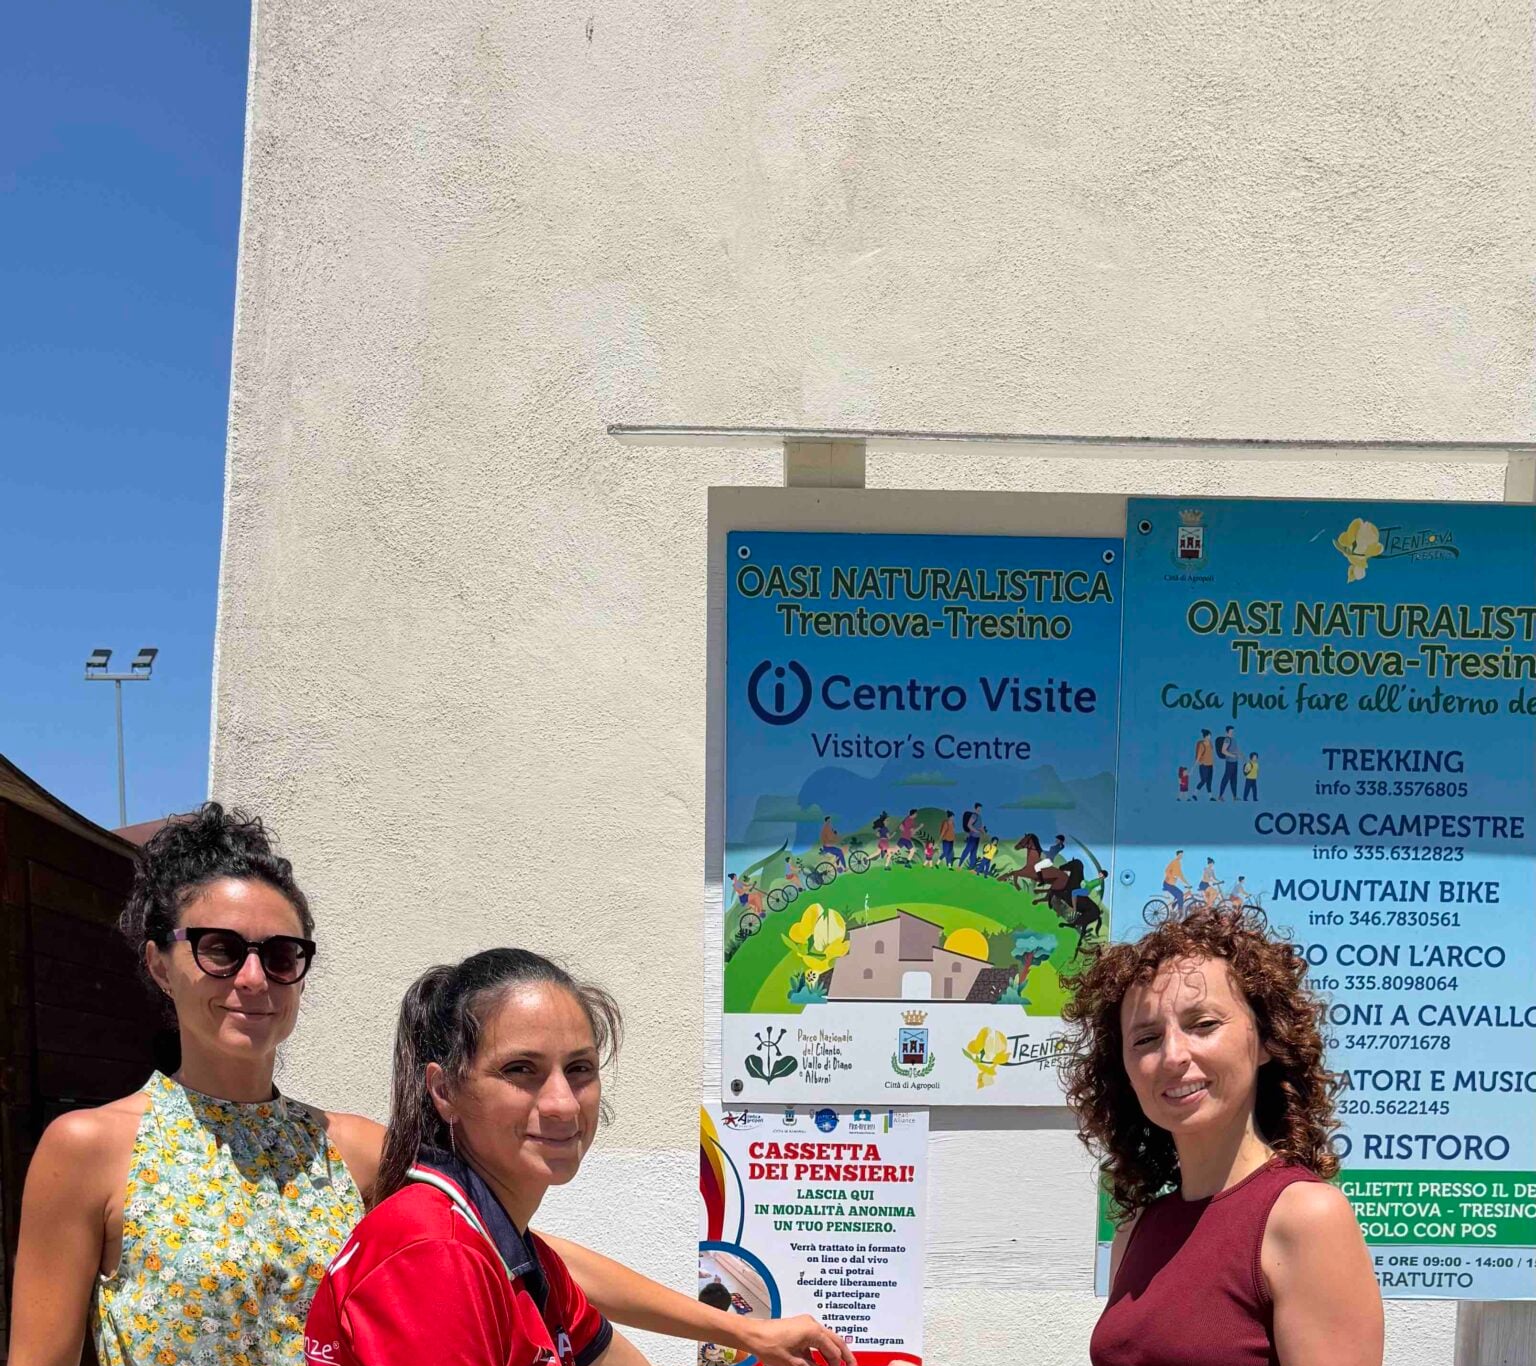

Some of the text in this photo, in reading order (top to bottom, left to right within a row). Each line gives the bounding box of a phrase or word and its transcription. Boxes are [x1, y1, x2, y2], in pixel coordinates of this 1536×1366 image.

[737, 565, 1113, 603] OASI NATURALISTICA
[776, 603, 1072, 640] Trentova-Tresino
[1187, 600, 1536, 641] OASI NATURALIST
[1232, 640, 1536, 680] Trentova-Tresin
[821, 674, 1097, 713] Centro Visite
[1161, 683, 1224, 711] Cosa
[1232, 686, 1288, 718] puoi
[1297, 683, 1349, 714] fare
[1358, 684, 1498, 715] all'interno
[811, 732, 1031, 760] Visitor's Centre
[1322, 748, 1464, 773] TREKKING
[1315, 780, 1468, 798] info 338.3576805
[1254, 811, 1525, 839] CORSA CAMPESTRE
[1313, 845, 1465, 862] info 335.6312823
[1271, 878, 1500, 904] MOUNTAIN BIKE
[1308, 910, 1460, 928] info 346.7830561
[1336, 945, 1400, 967] CON
[1409, 945, 1506, 968] L'ARCO
[1345, 975, 1458, 991] 335.8098064
[1390, 1004, 1410, 1026] A
[797, 1029, 853, 1044] Parco Nazionale
[1345, 1034, 1450, 1050] 347.7071678
[802, 1043, 814, 1056] del
[802, 1057, 853, 1070] Vallo di Diano
[805, 1070, 831, 1085] Alburni
[1431, 1070, 1445, 1091] E
[884, 1081, 940, 1091] Città di Agropoli
[1338, 1100, 1450, 1116] 320.5622145
[749, 1142, 882, 1161] CASSETTA
[1363, 1134, 1511, 1160] RISTORO
[749, 1163, 915, 1182] DEI PENSIERI!
[797, 1189, 874, 1201] LASCIA QUI
[1418, 1182, 1487, 1198] PRESSO
[1491, 1183, 1509, 1198] IL
[754, 1202, 916, 1217] IN MODALITÀ ANONIMA
[774, 1220, 896, 1233] UN TUO PENSIERO.
[1359, 1222, 1497, 1238] SOLO CON POS
[790, 1242, 906, 1253] Verrà trattato in formato
[821, 1254, 839, 1263] line
[850, 1255, 865, 1263] dal
[867, 1255, 888, 1264] vivo
[1388, 1256, 1419, 1266] ORE
[1423, 1256, 1461, 1267] 09:00
[1476, 1257, 1513, 1268] 14:00
[828, 1267, 843, 1275] cui
[845, 1267, 874, 1277] potrai
[797, 1278, 897, 1287] decidere liberamente
[813, 1289, 880, 1301] di partecipare
[825, 1301, 876, 1310] riascoltare
[822, 1313, 871, 1321] attraverso
[835, 1325, 868, 1334] pagine
[855, 1336, 904, 1346] Instagram
